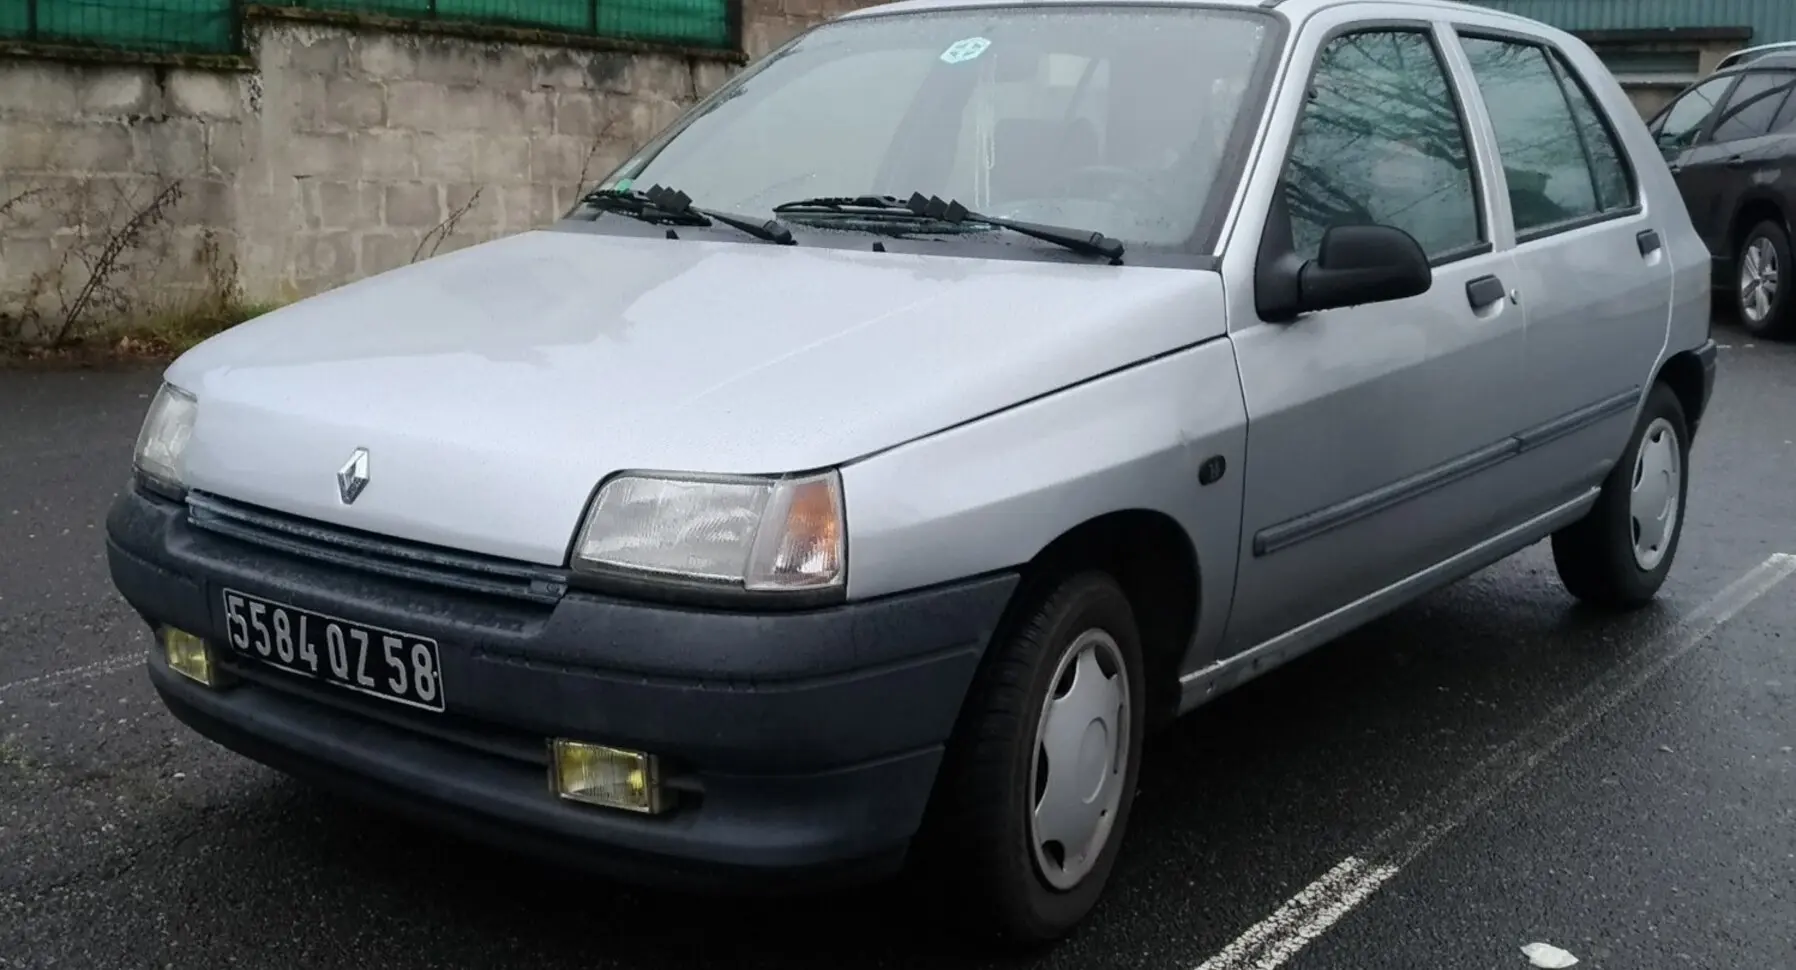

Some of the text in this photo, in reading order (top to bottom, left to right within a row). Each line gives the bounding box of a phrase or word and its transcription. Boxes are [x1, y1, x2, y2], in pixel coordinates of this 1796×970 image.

[227, 595, 436, 701] 5584 QZ 58
